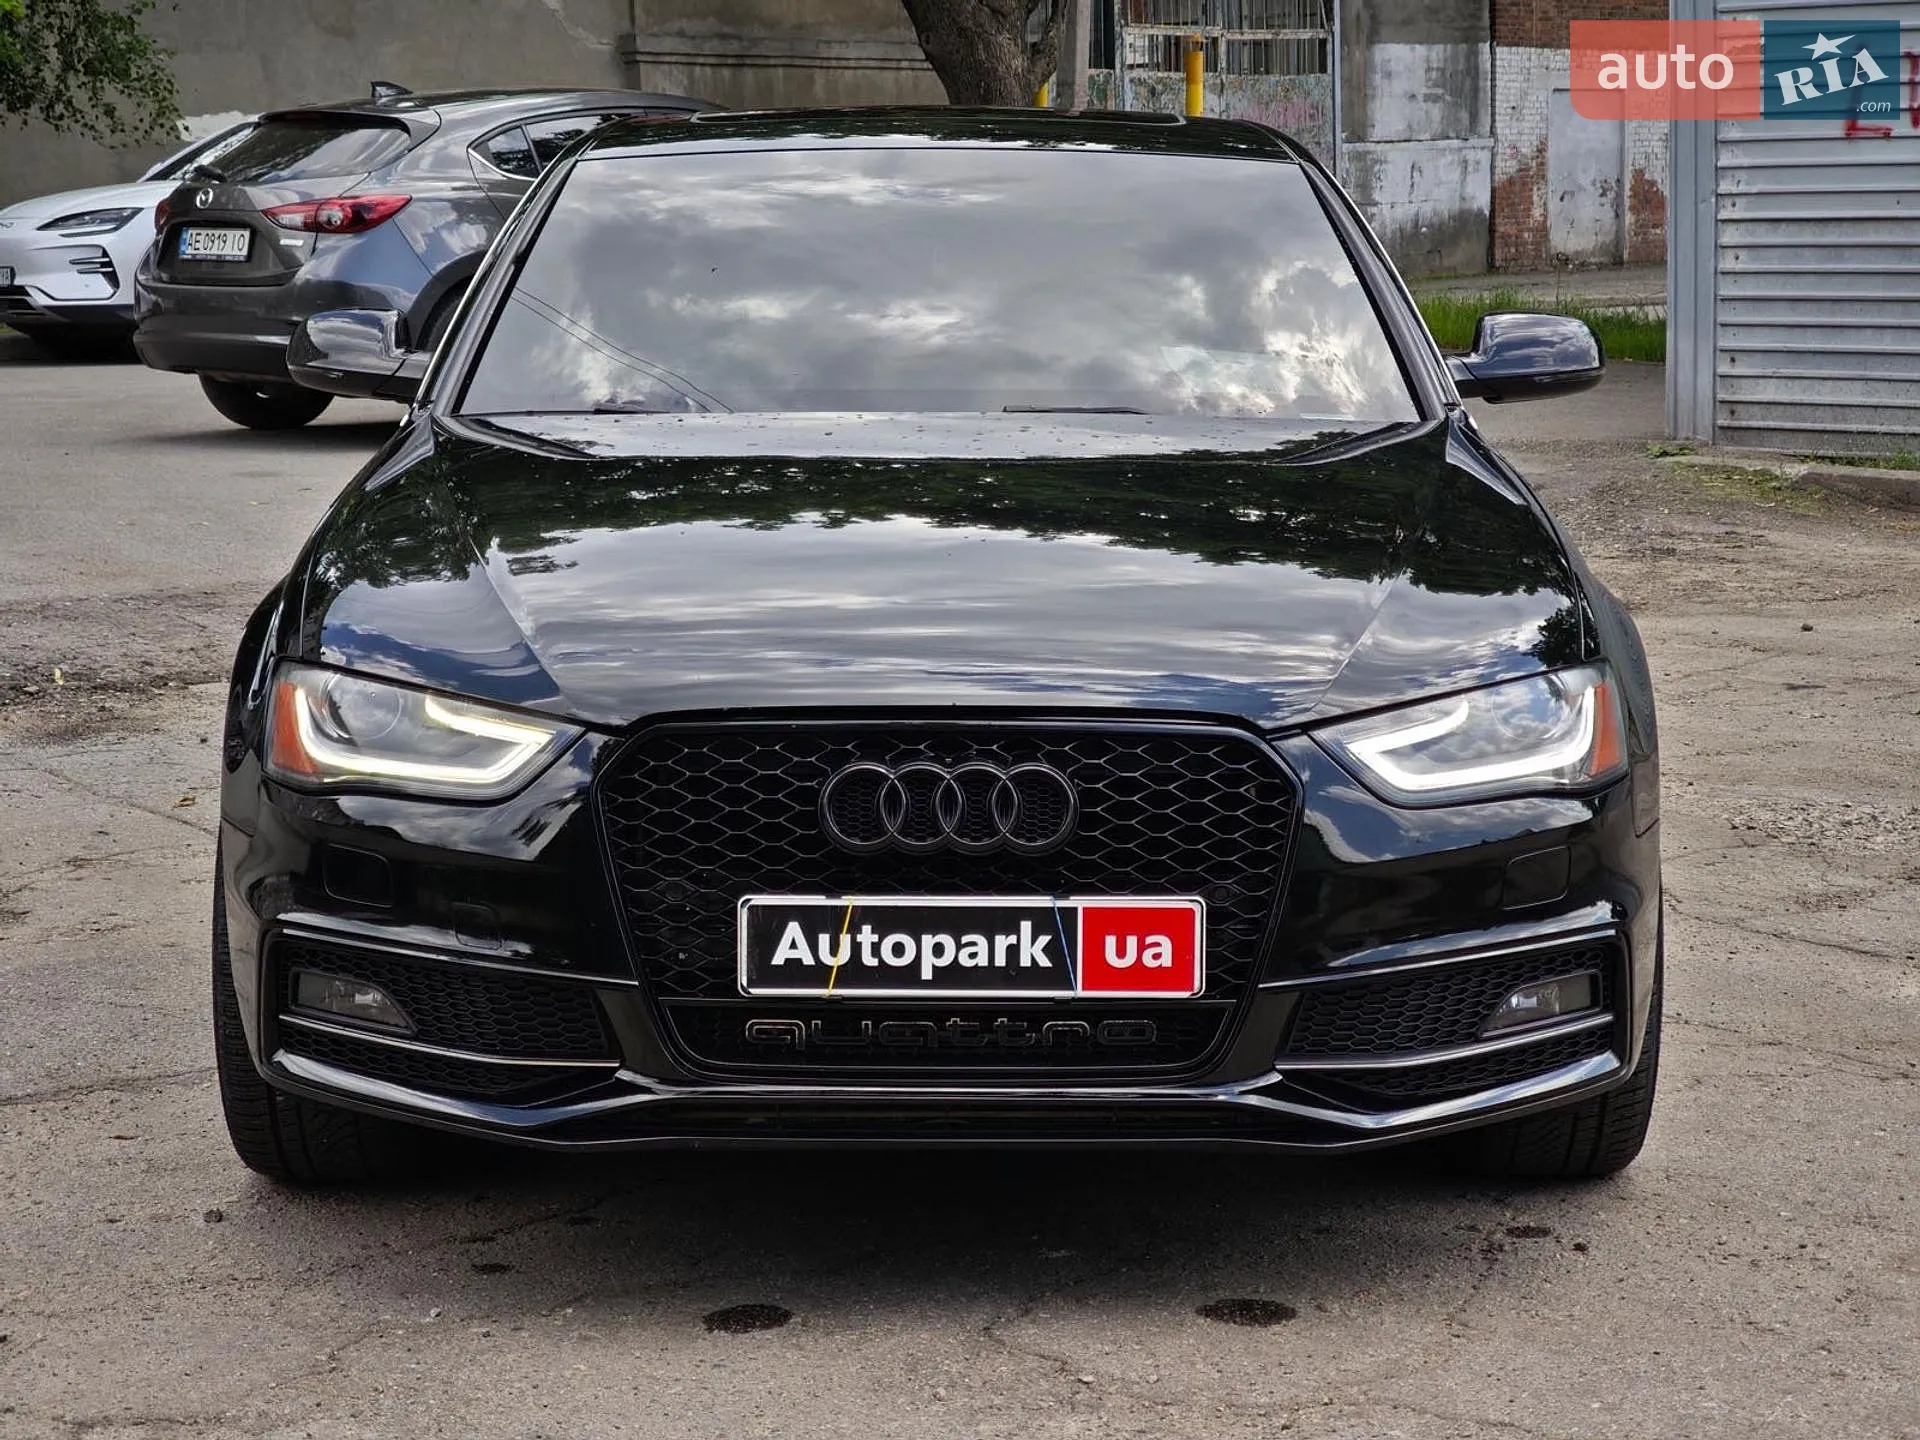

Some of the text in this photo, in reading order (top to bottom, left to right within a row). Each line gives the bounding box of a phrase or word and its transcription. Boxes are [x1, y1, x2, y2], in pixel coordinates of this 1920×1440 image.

[770, 921, 1173, 980] Autopark ua
[745, 1017, 1157, 1051] quattro
